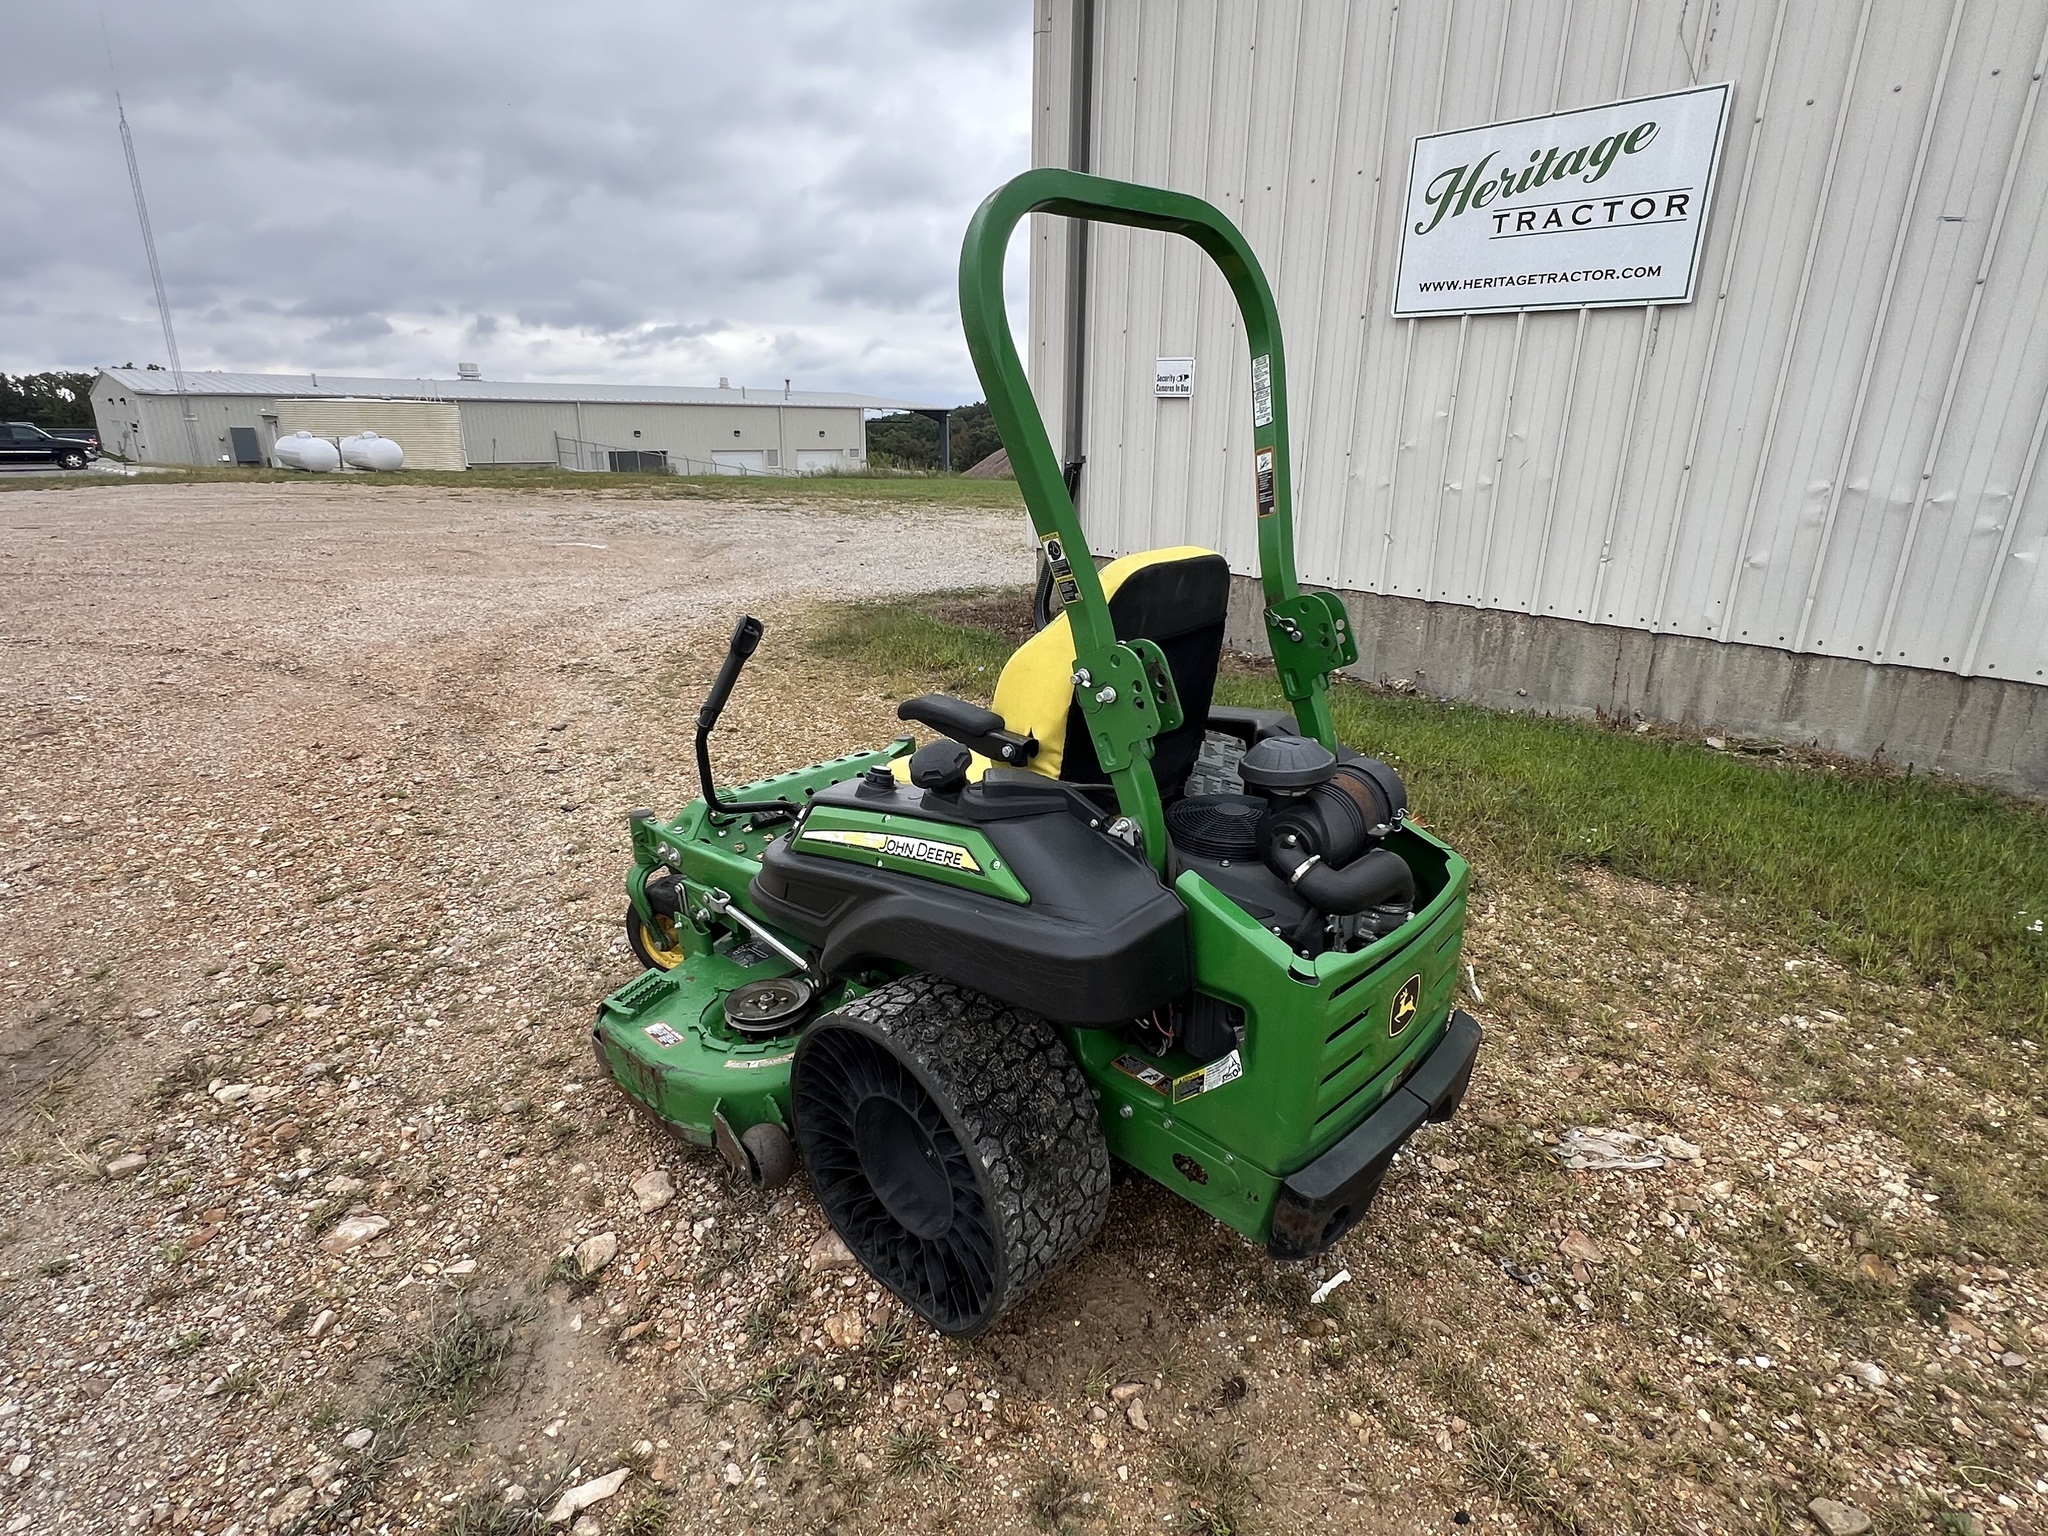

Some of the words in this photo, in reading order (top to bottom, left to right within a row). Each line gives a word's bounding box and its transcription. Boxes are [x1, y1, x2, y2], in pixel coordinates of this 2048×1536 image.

[1414, 121, 1661, 236] Heritage
[1492, 193, 1690, 234] TRACTOR
[1156, 374, 1175, 383] Security
[1156, 384, 1174, 392] Cameras
[1181, 384, 1189, 392] Use
[878, 836, 915, 856] JOHN
[916, 843, 963, 866] DEERE
